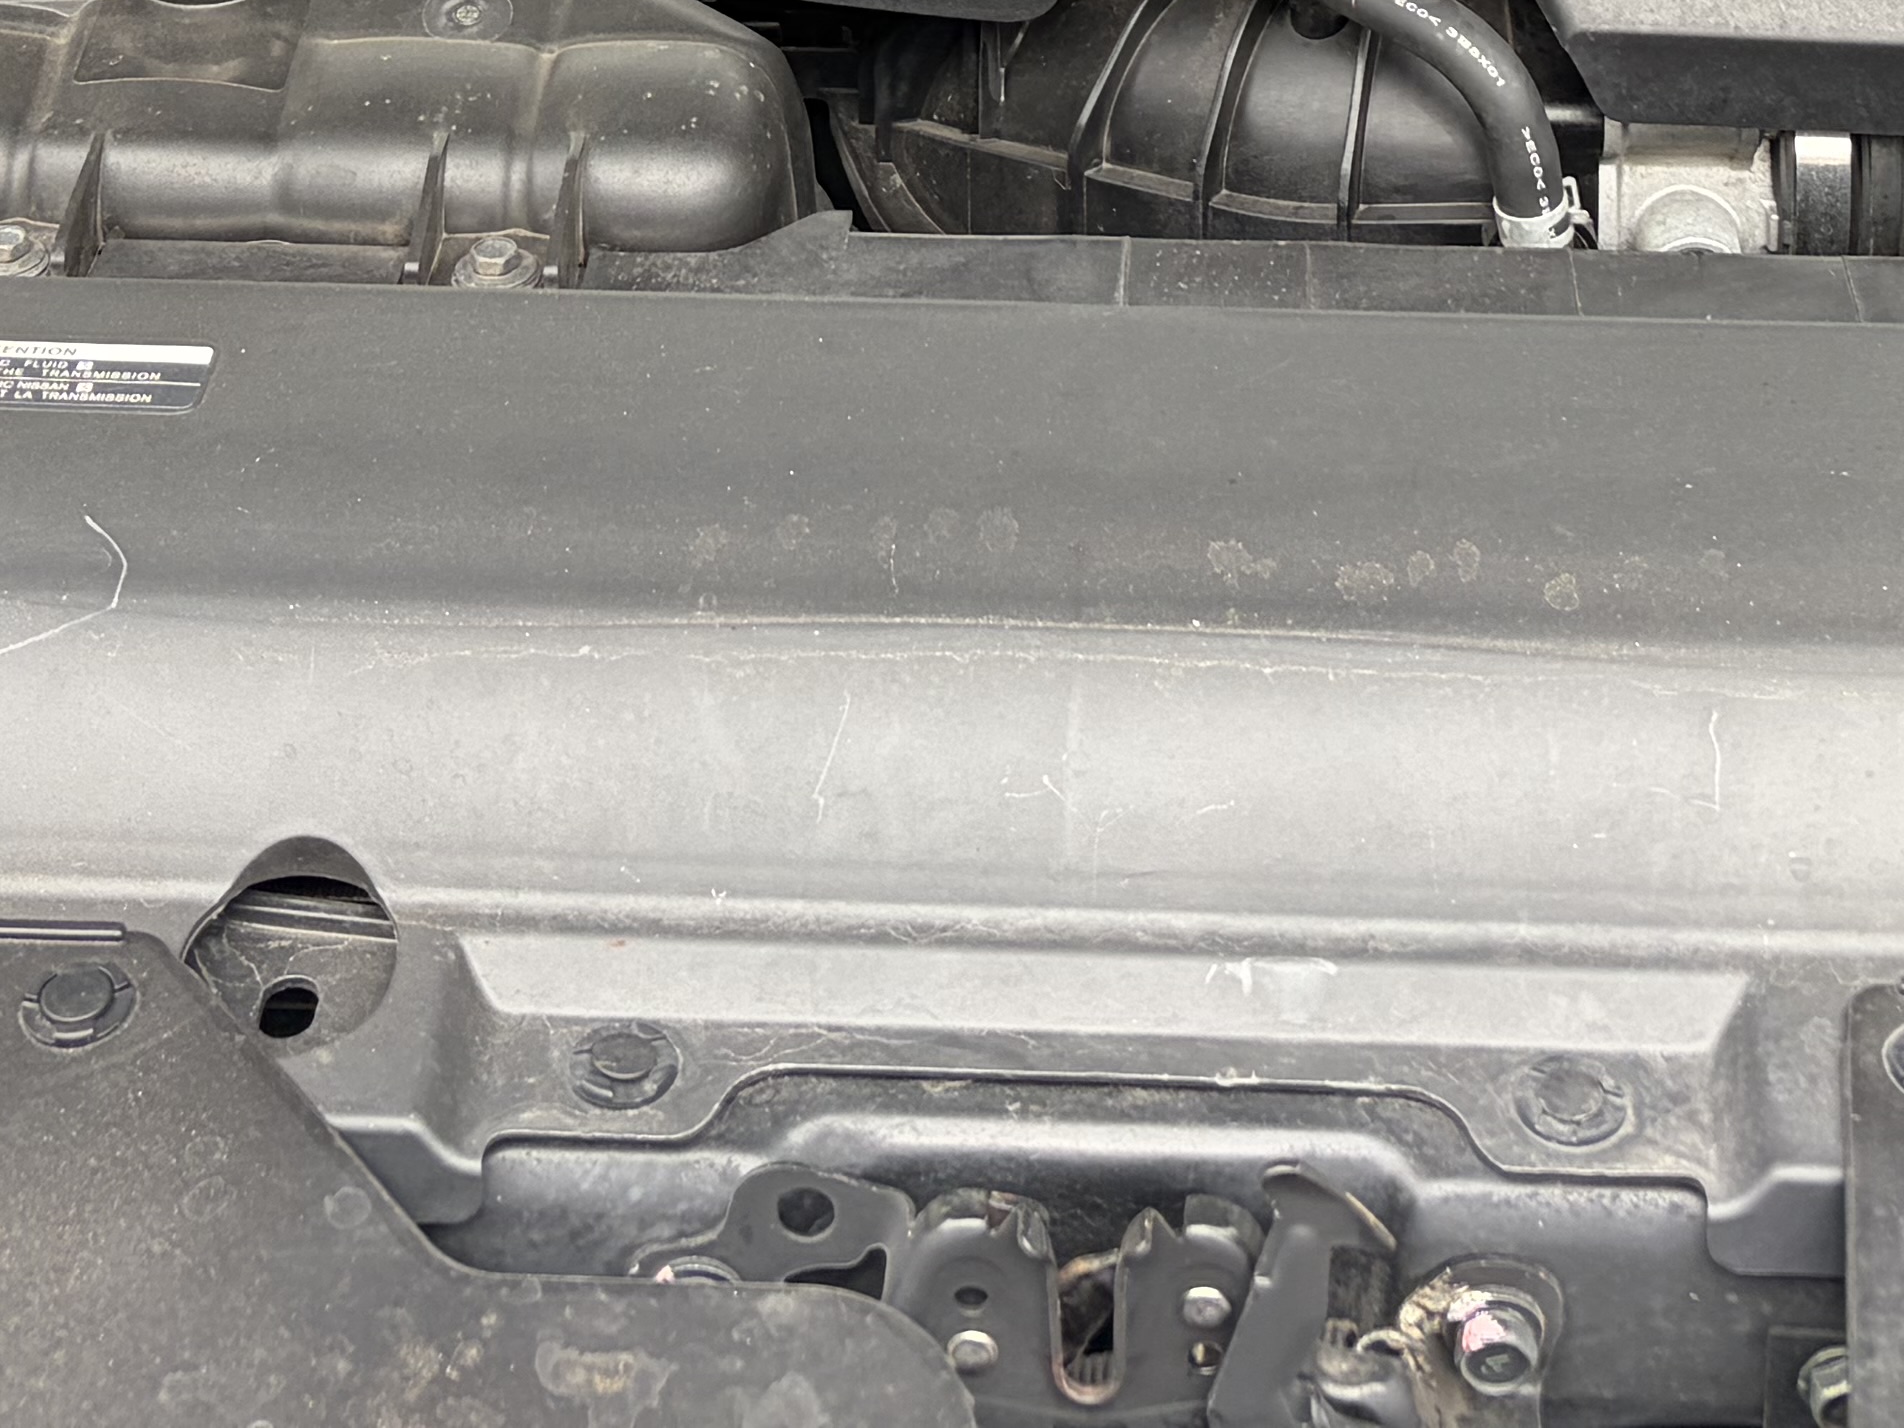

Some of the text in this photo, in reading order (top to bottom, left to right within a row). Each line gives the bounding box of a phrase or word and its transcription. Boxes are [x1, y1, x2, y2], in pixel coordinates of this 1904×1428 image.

[23, 359, 69, 369] FLUID
[42, 368, 162, 381] TRANSMISSION
[16, 381, 70, 391] NISSAN
[14, 390, 34, 400] LA
[42, 390, 153, 404] TRANSMISSION
